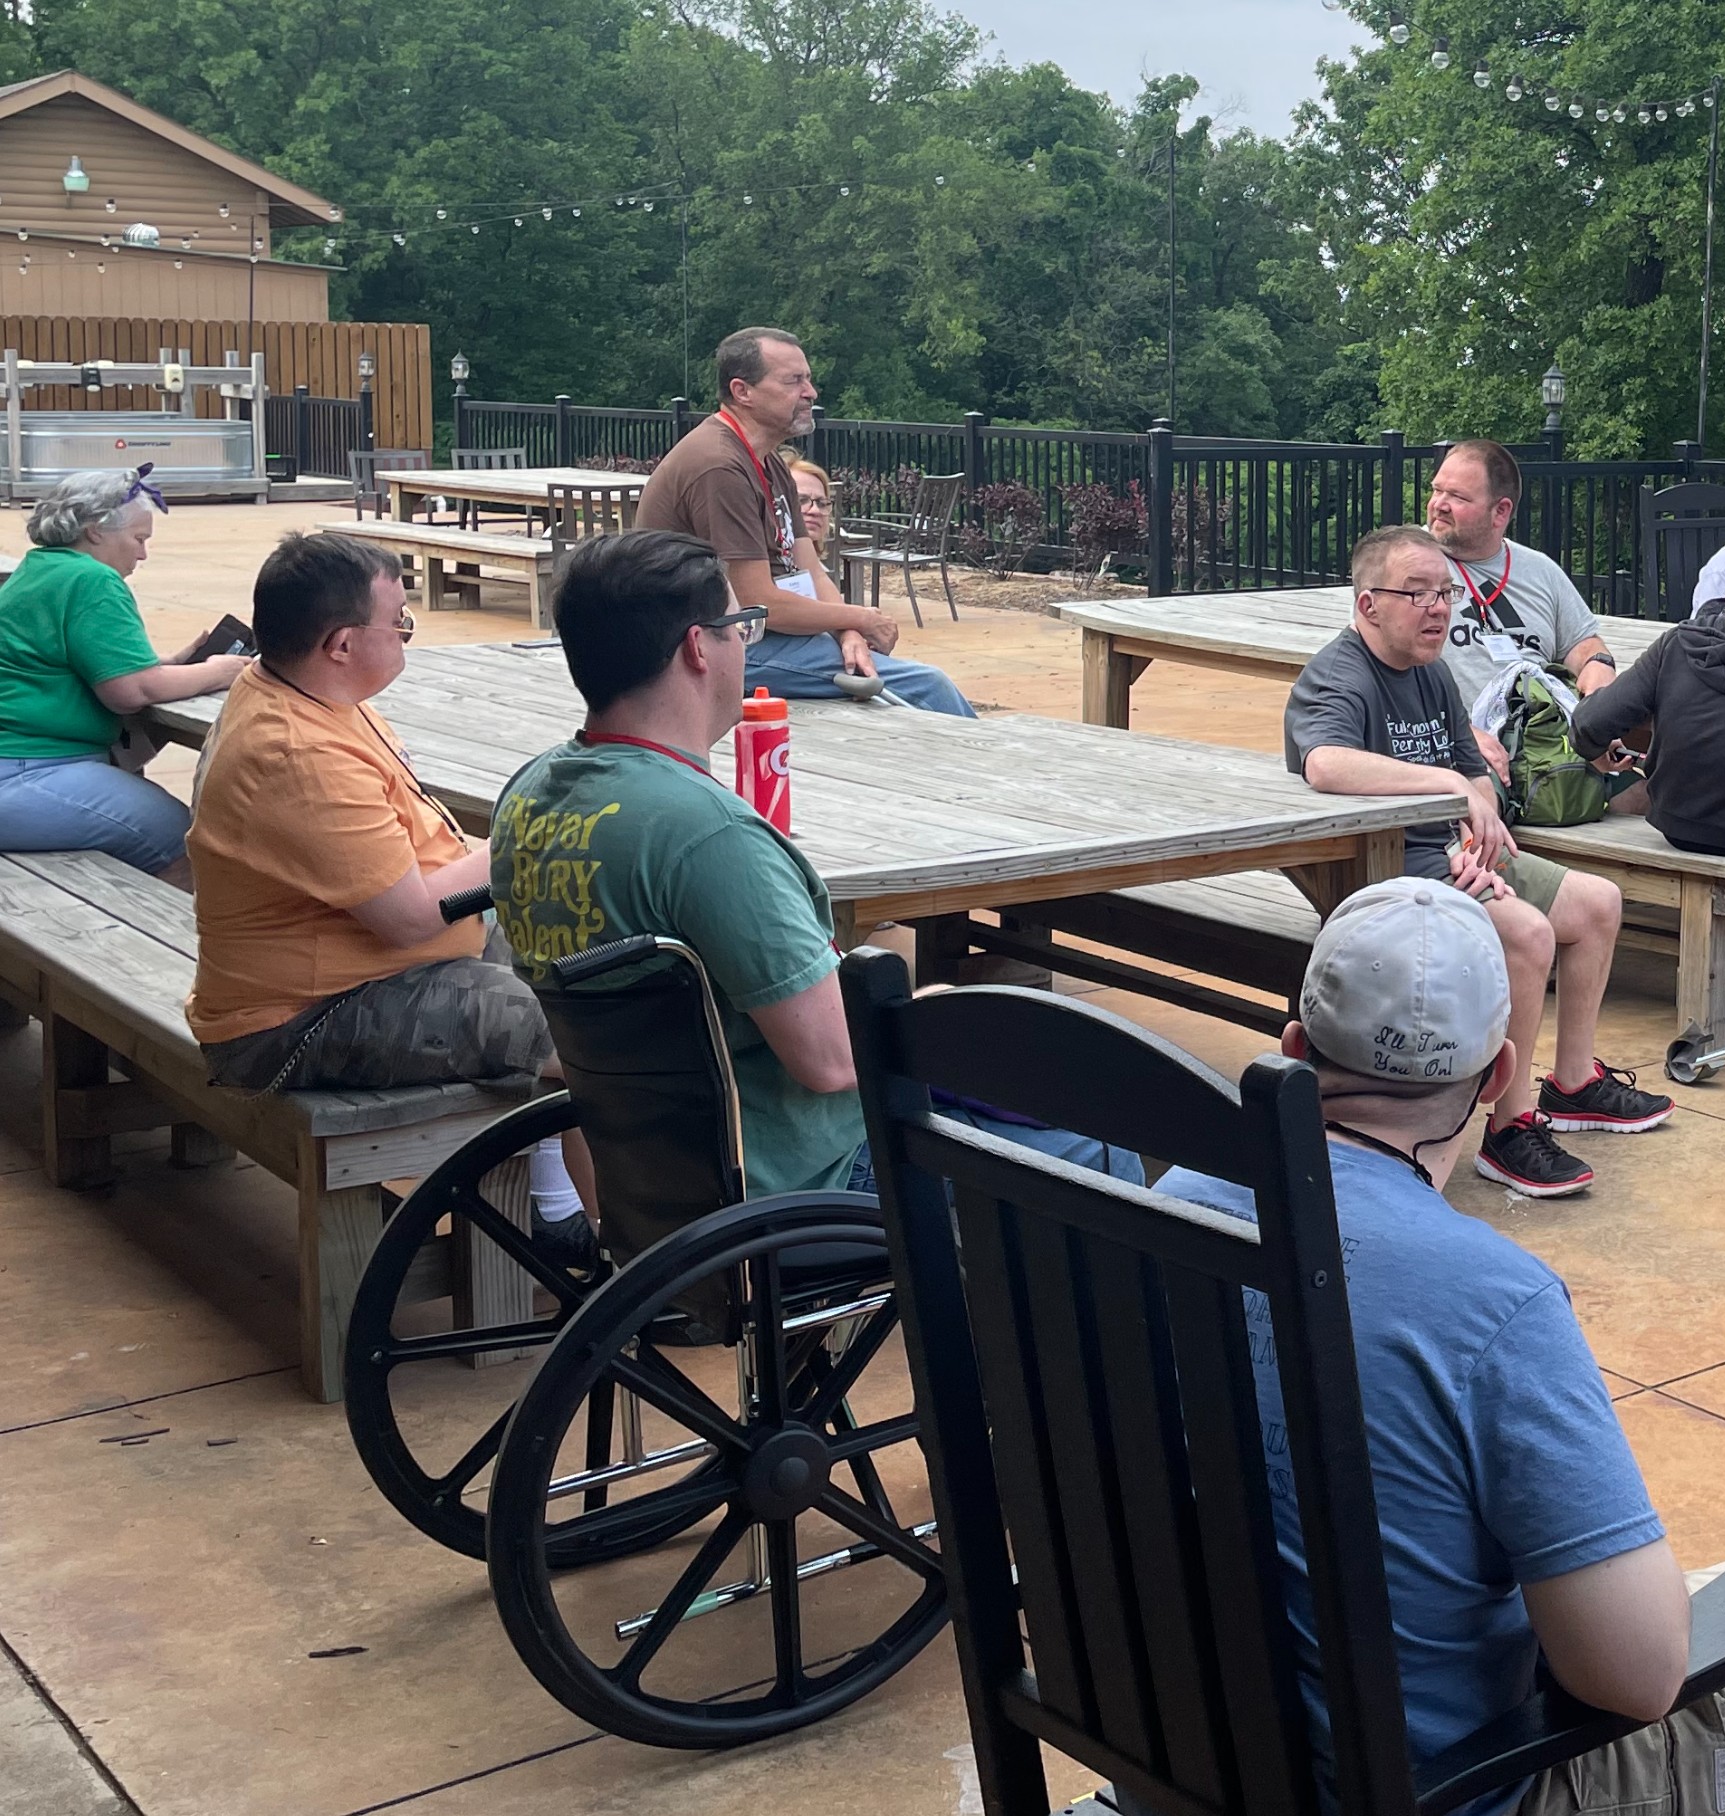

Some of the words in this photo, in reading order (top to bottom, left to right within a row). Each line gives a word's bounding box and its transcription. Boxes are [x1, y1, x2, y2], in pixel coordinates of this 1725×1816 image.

[1449, 623, 1541, 651] adas
[494, 794, 621, 854] Never
[1373, 1026, 1406, 1050] I'll
[1417, 1031, 1459, 1053] Turn
[1373, 1051, 1410, 1076] You
[1424, 1055, 1453, 1077] On!
